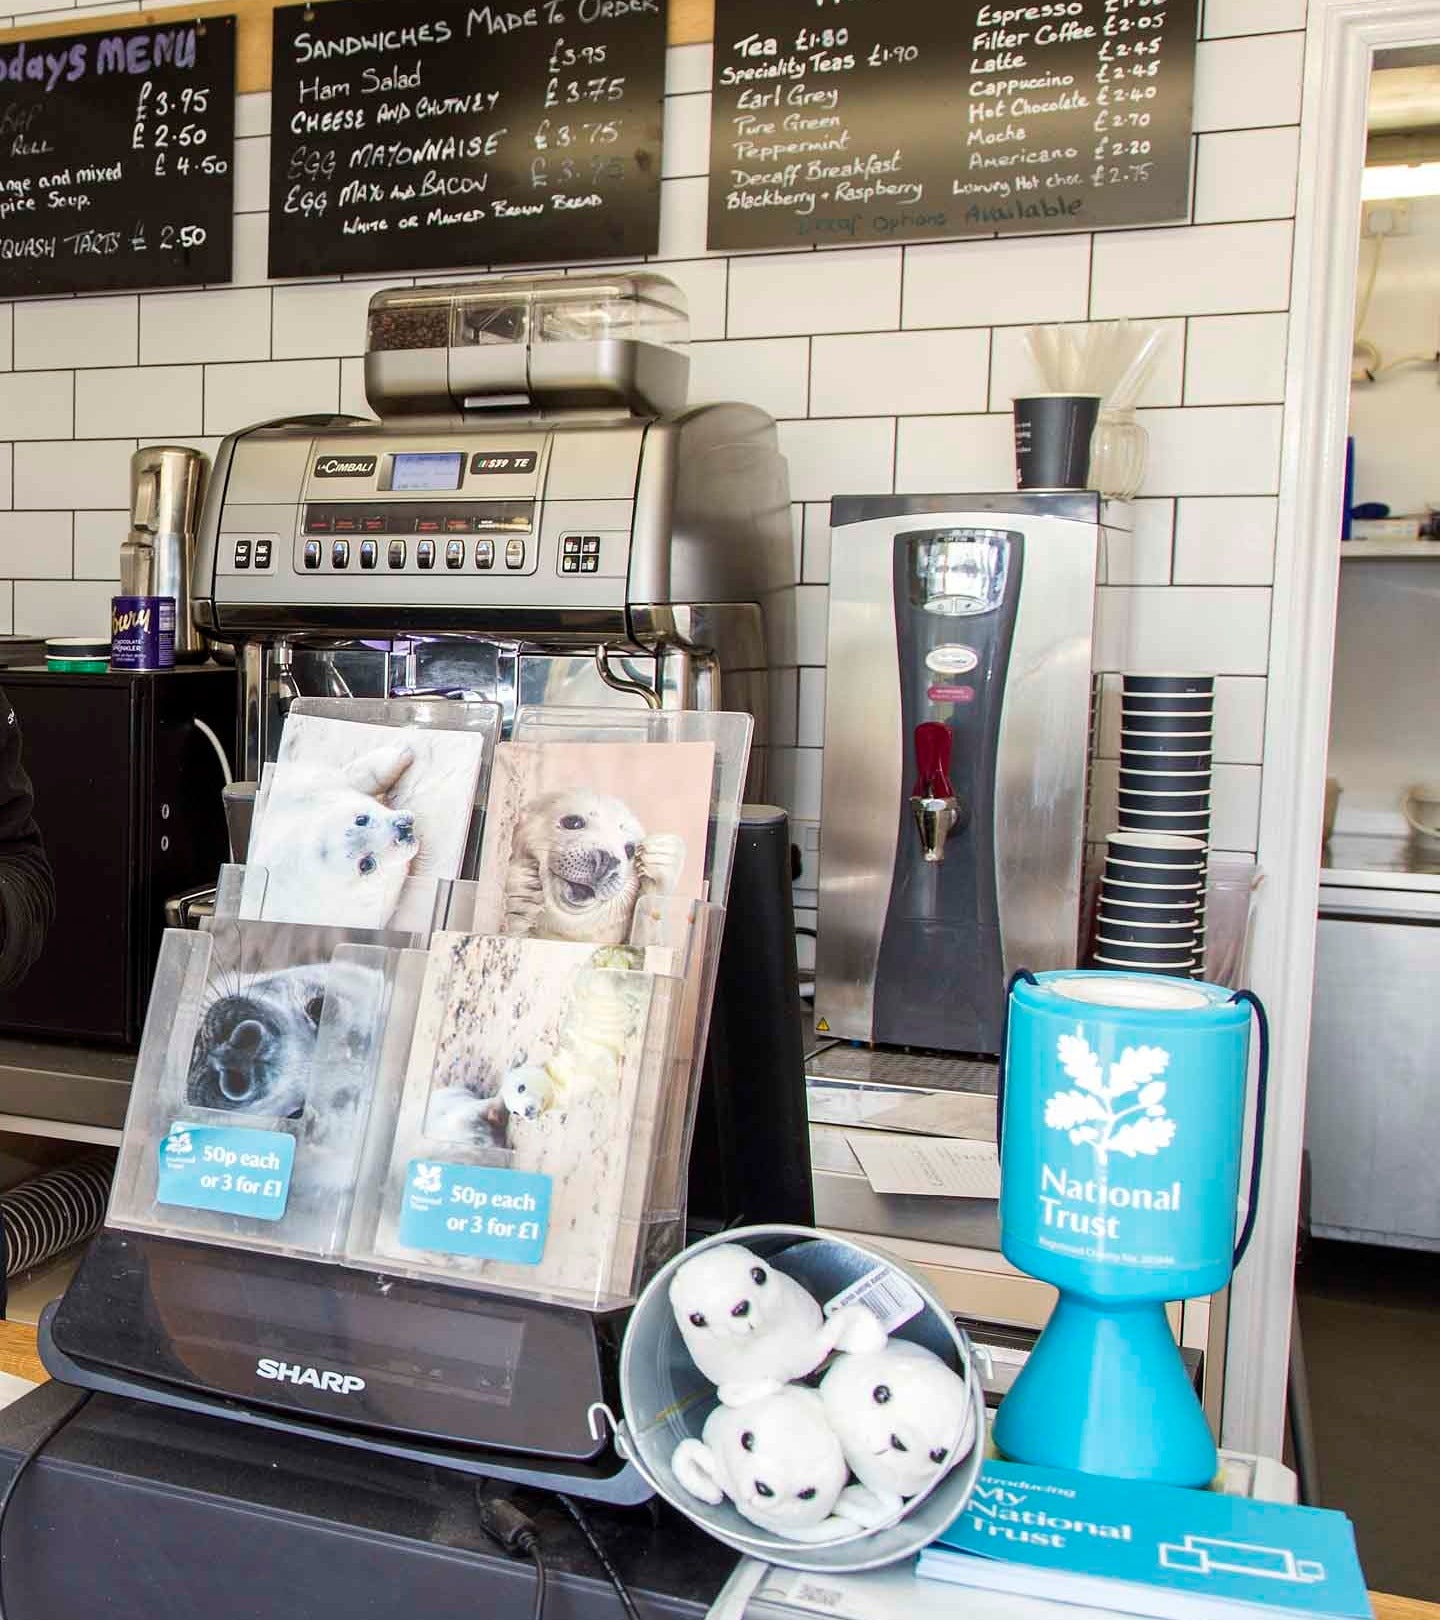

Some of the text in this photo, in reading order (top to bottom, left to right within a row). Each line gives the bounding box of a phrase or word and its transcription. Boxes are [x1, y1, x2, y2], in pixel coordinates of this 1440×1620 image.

[976, 2, 1083, 27] Espresso
[294, 21, 452, 63] SANDWICHES
[734, 27, 848, 58] Tea £1.80
[973, 30, 1030, 51] Filter
[1034, 20, 1096, 45] Coffee
[97, 29, 195, 75] MENU
[720, 43, 918, 84] Speciality Teas £1.90
[969, 53, 1027, 74] Latte
[299, 76, 349, 102] Ham
[362, 60, 421, 94] Salad
[969, 71, 1074, 98] Cappuccino
[736, 84, 839, 110] Earl Grey
[969, 101, 1006, 124] Hot
[1010, 94, 1090, 117] Chocolate
[291, 108, 365, 134] CHEESE
[377, 101, 411, 124] AND
[784, 113, 840, 132] Green
[349, 128, 508, 169] MAYONNAISE
[733, 130, 851, 161] Peppermint
[966, 126, 1026, 146] Mocha
[731, 149, 903, 188] Decaff Breakfast
[969, 148, 1078, 170] Americano
[39, 168, 71, 189] and
[77, 162, 122, 182] mixed
[1016, 176, 1040, 191] Hot
[285, 184, 327, 219] EGG
[421, 170, 487, 198] BACON
[726, 192, 815, 215] Blackberry
[834, 180, 923, 204] Raspberry
[203, 1145, 237, 1168] 50p
[241, 1152, 280, 1170] each
[200, 1174, 283, 1198] or 3 for £1
[450, 1184, 488, 1209] 50p
[491, 1193, 536, 1211] each
[1041, 1163, 1181, 1211] National
[446, 1215, 539, 1240] or 3 for £1
[1039, 1195, 1120, 1239] Trust
[255, 1358, 366, 1395] SHARP
[974, 1483, 1028, 1506] My
[980, 1476, 1077, 1499] ntroducing
[964, 1512, 1067, 1548] Trust
[967, 1499, 1132, 1542] National
